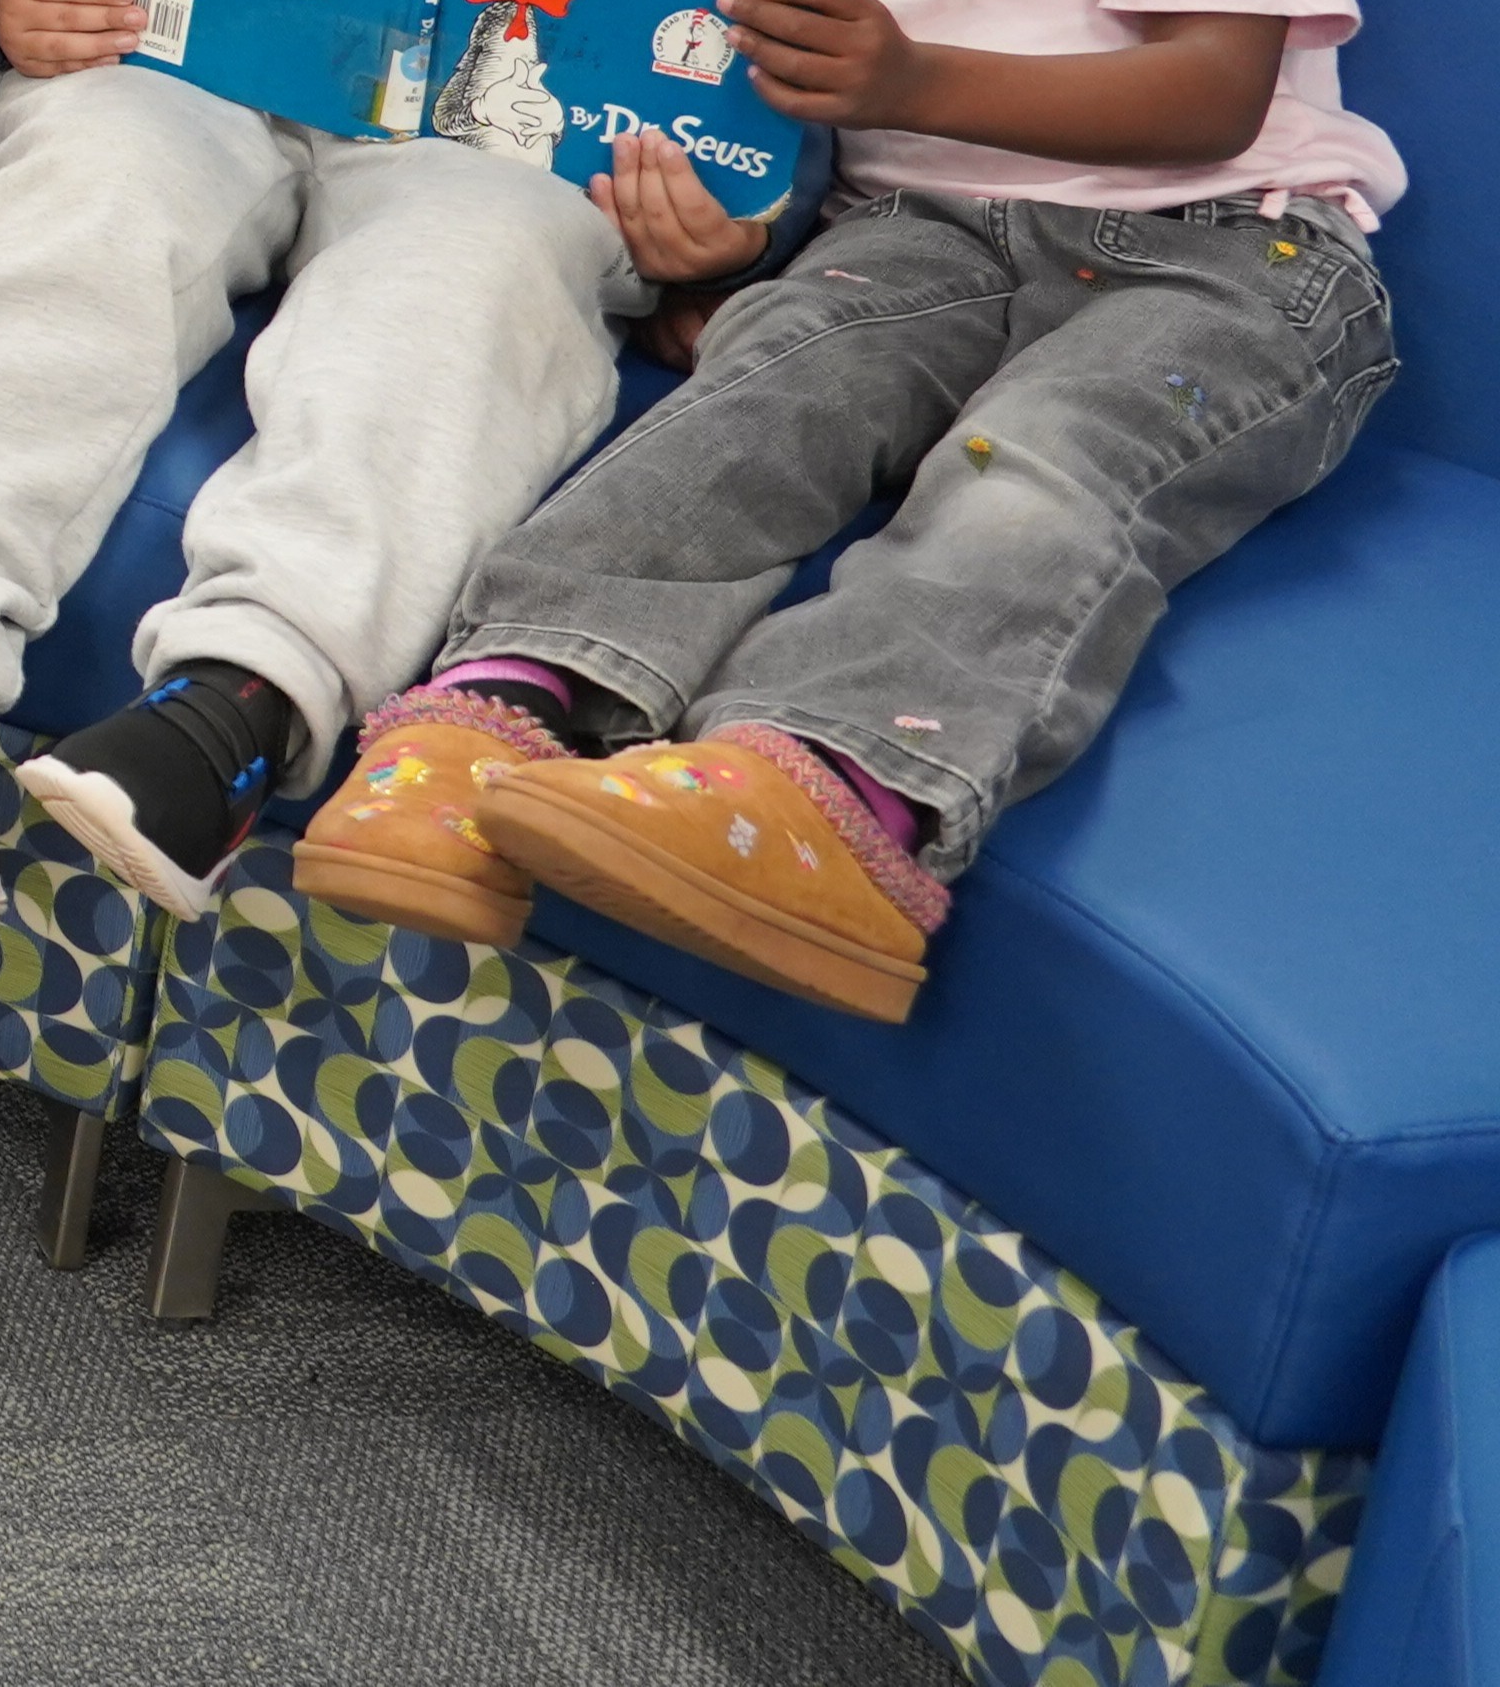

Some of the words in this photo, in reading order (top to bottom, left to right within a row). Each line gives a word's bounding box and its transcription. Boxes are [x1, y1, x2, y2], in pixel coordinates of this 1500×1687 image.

[660, 16, 679, 33] READ
[709, 18, 722, 29] ALL
[655, 62, 692, 75] Beginner
[693, 71, 719, 82] Books
[570, 106, 601, 131] By
[672, 115, 773, 178] Seuss
